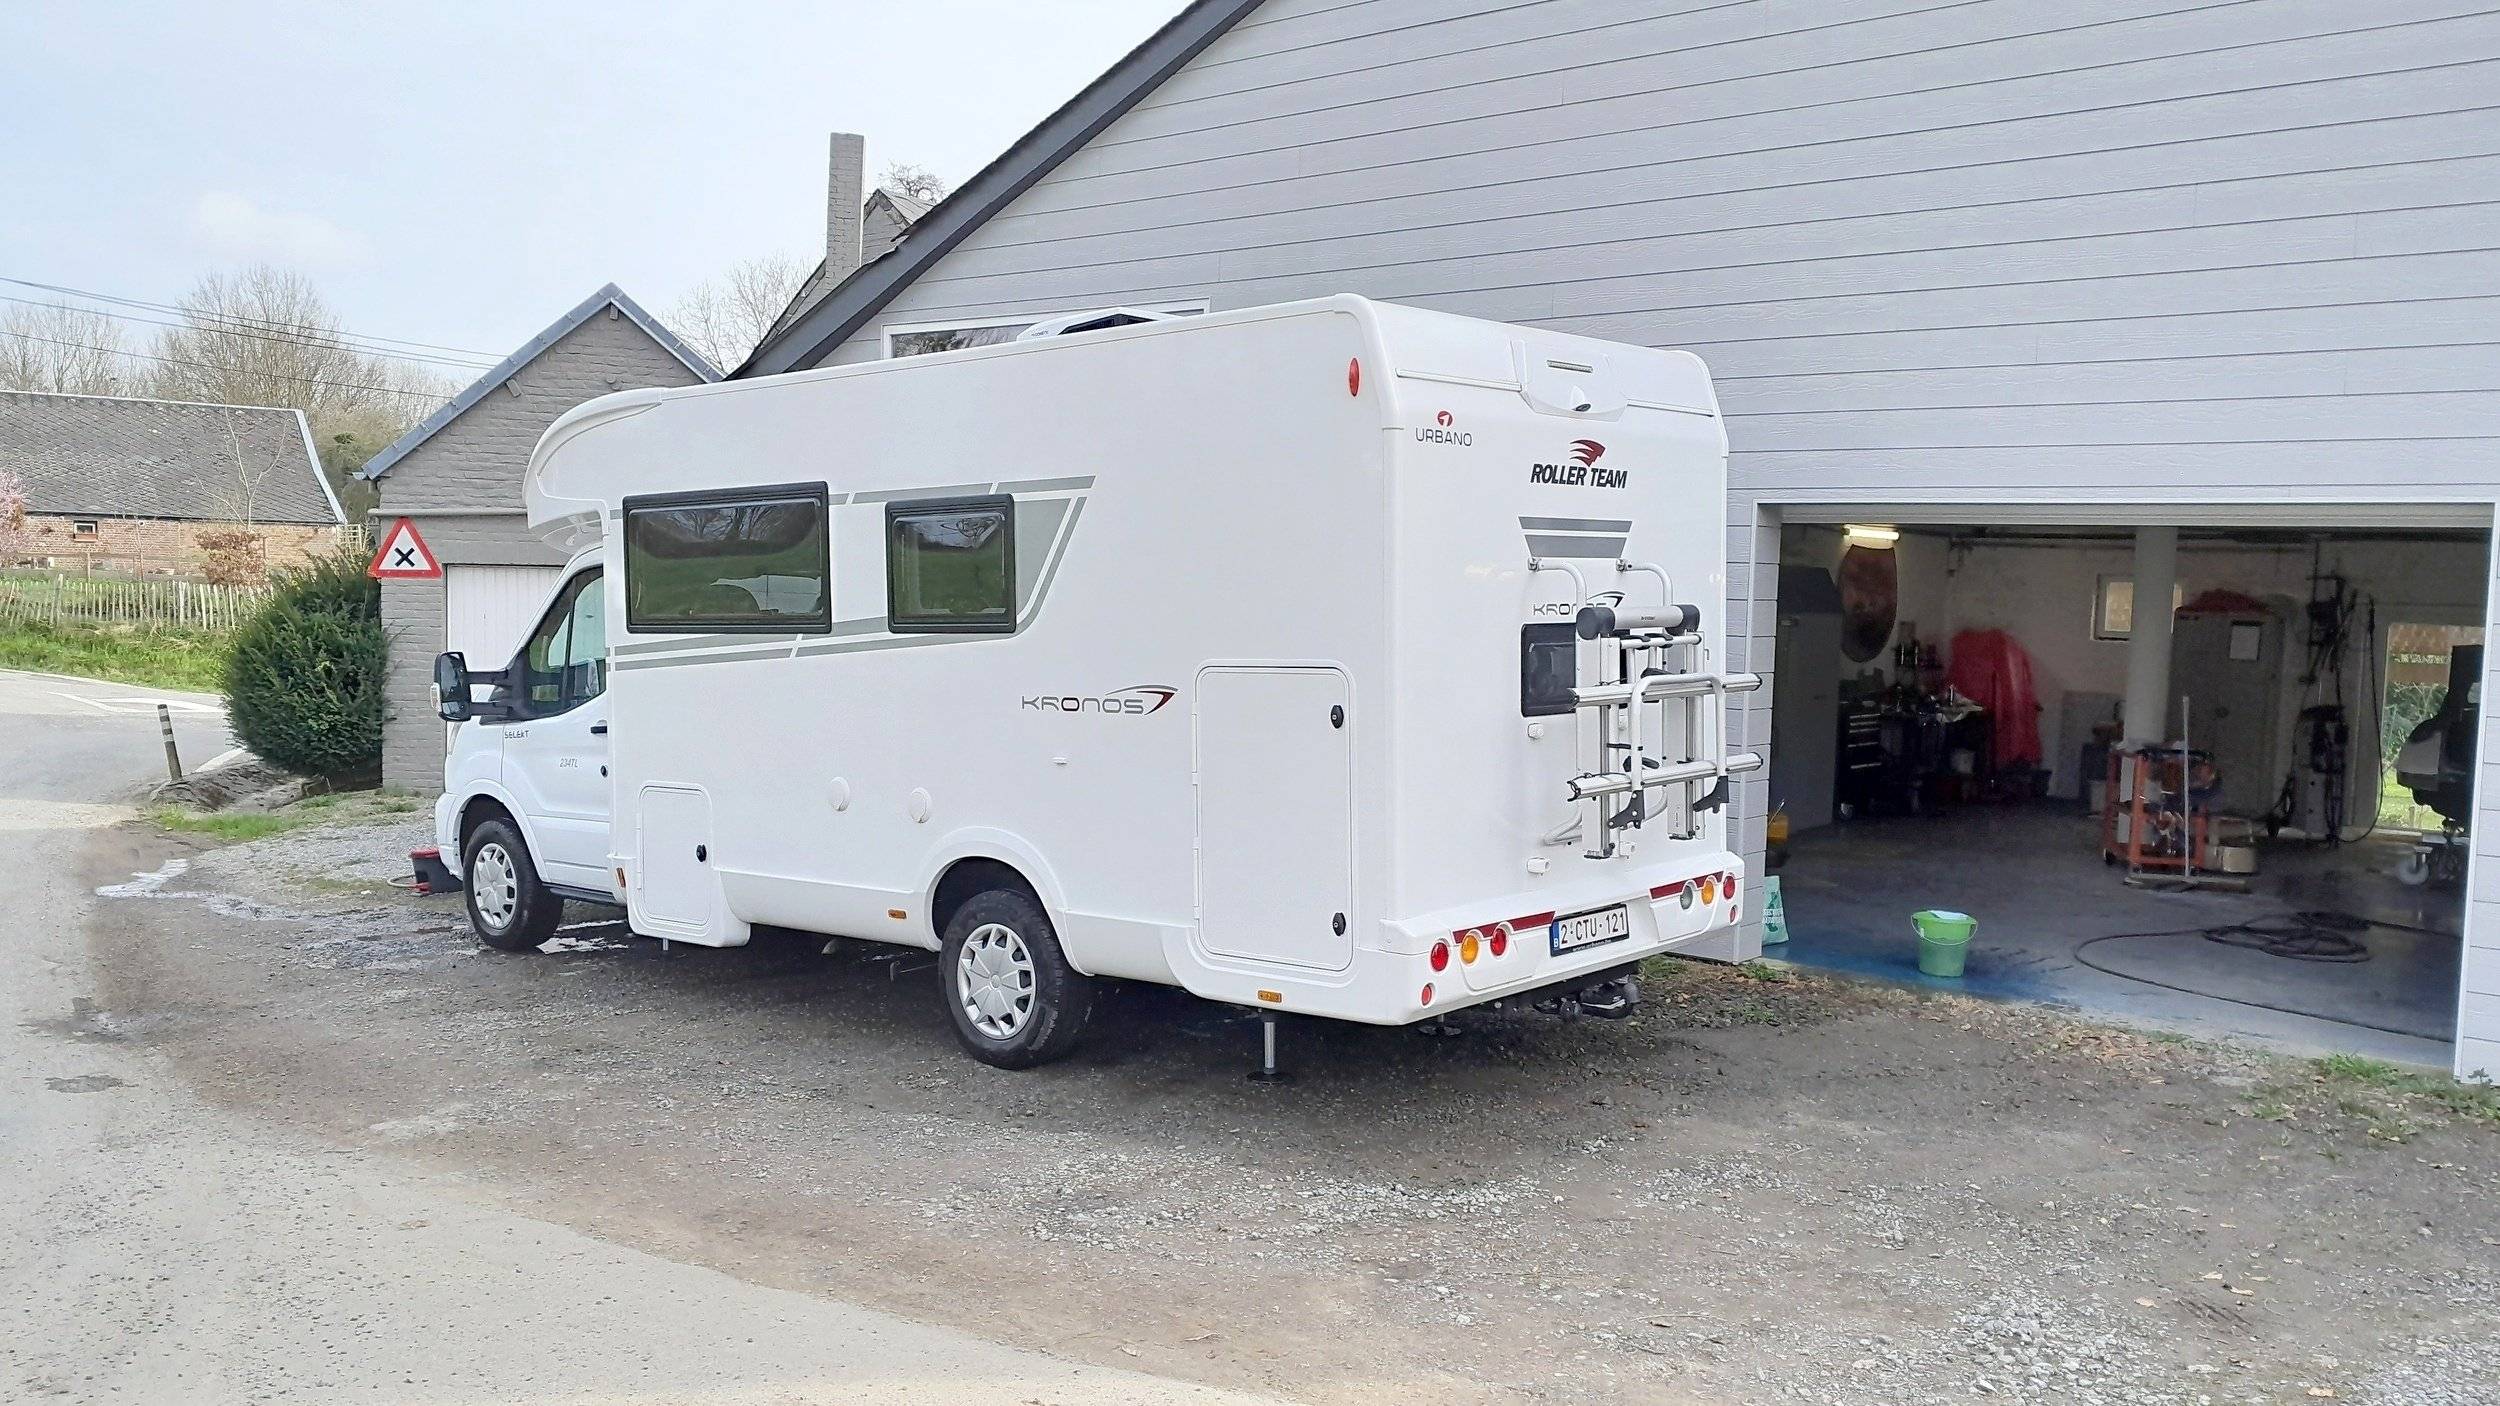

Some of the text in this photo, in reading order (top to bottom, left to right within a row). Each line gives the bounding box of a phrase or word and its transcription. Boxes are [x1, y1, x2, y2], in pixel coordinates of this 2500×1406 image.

[1415, 427, 1473, 447] URBANO
[1529, 463, 1628, 489] ROLLER TEAM
[1532, 602, 1607, 616] KRO
[1021, 695, 1145, 715] KRONOS
[559, 758, 579, 768] 234TL
[1560, 911, 1625, 945] 2-CTU-121
